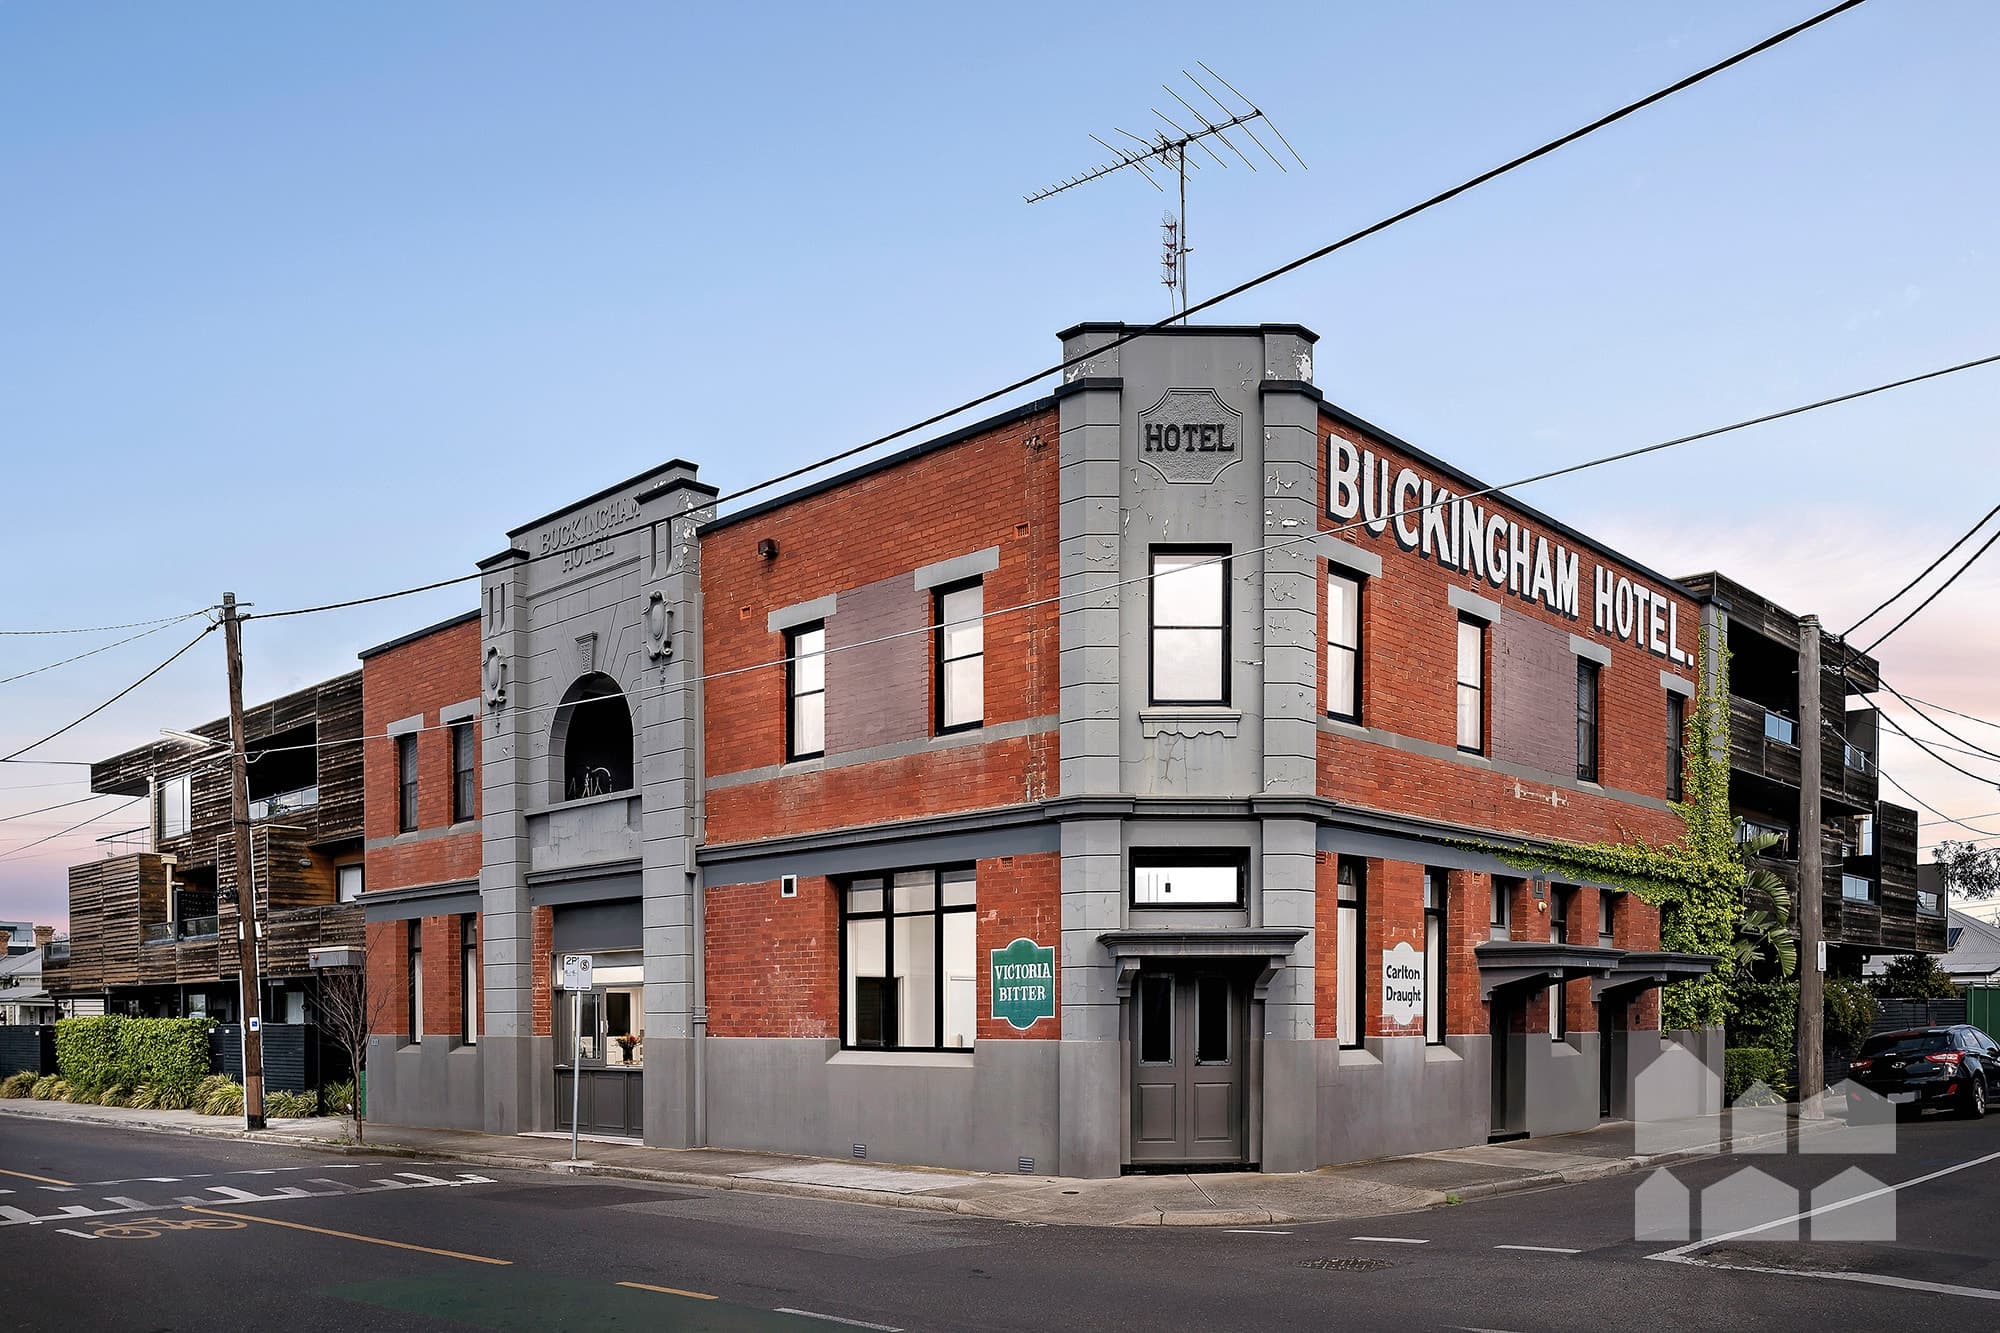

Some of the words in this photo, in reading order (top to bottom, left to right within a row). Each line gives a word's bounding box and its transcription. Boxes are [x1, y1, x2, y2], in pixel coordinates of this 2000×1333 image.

[1145, 424, 1235, 452] HOTEL
[1326, 433, 1579, 621] BUCKINGHAM
[1593, 563, 1694, 667] HOTEL.
[994, 962, 1052, 980] VICTORIA
[1386, 964, 1421, 980] Carlton
[999, 985, 1047, 1001] BITTER
[1386, 985, 1422, 1008] Draught
